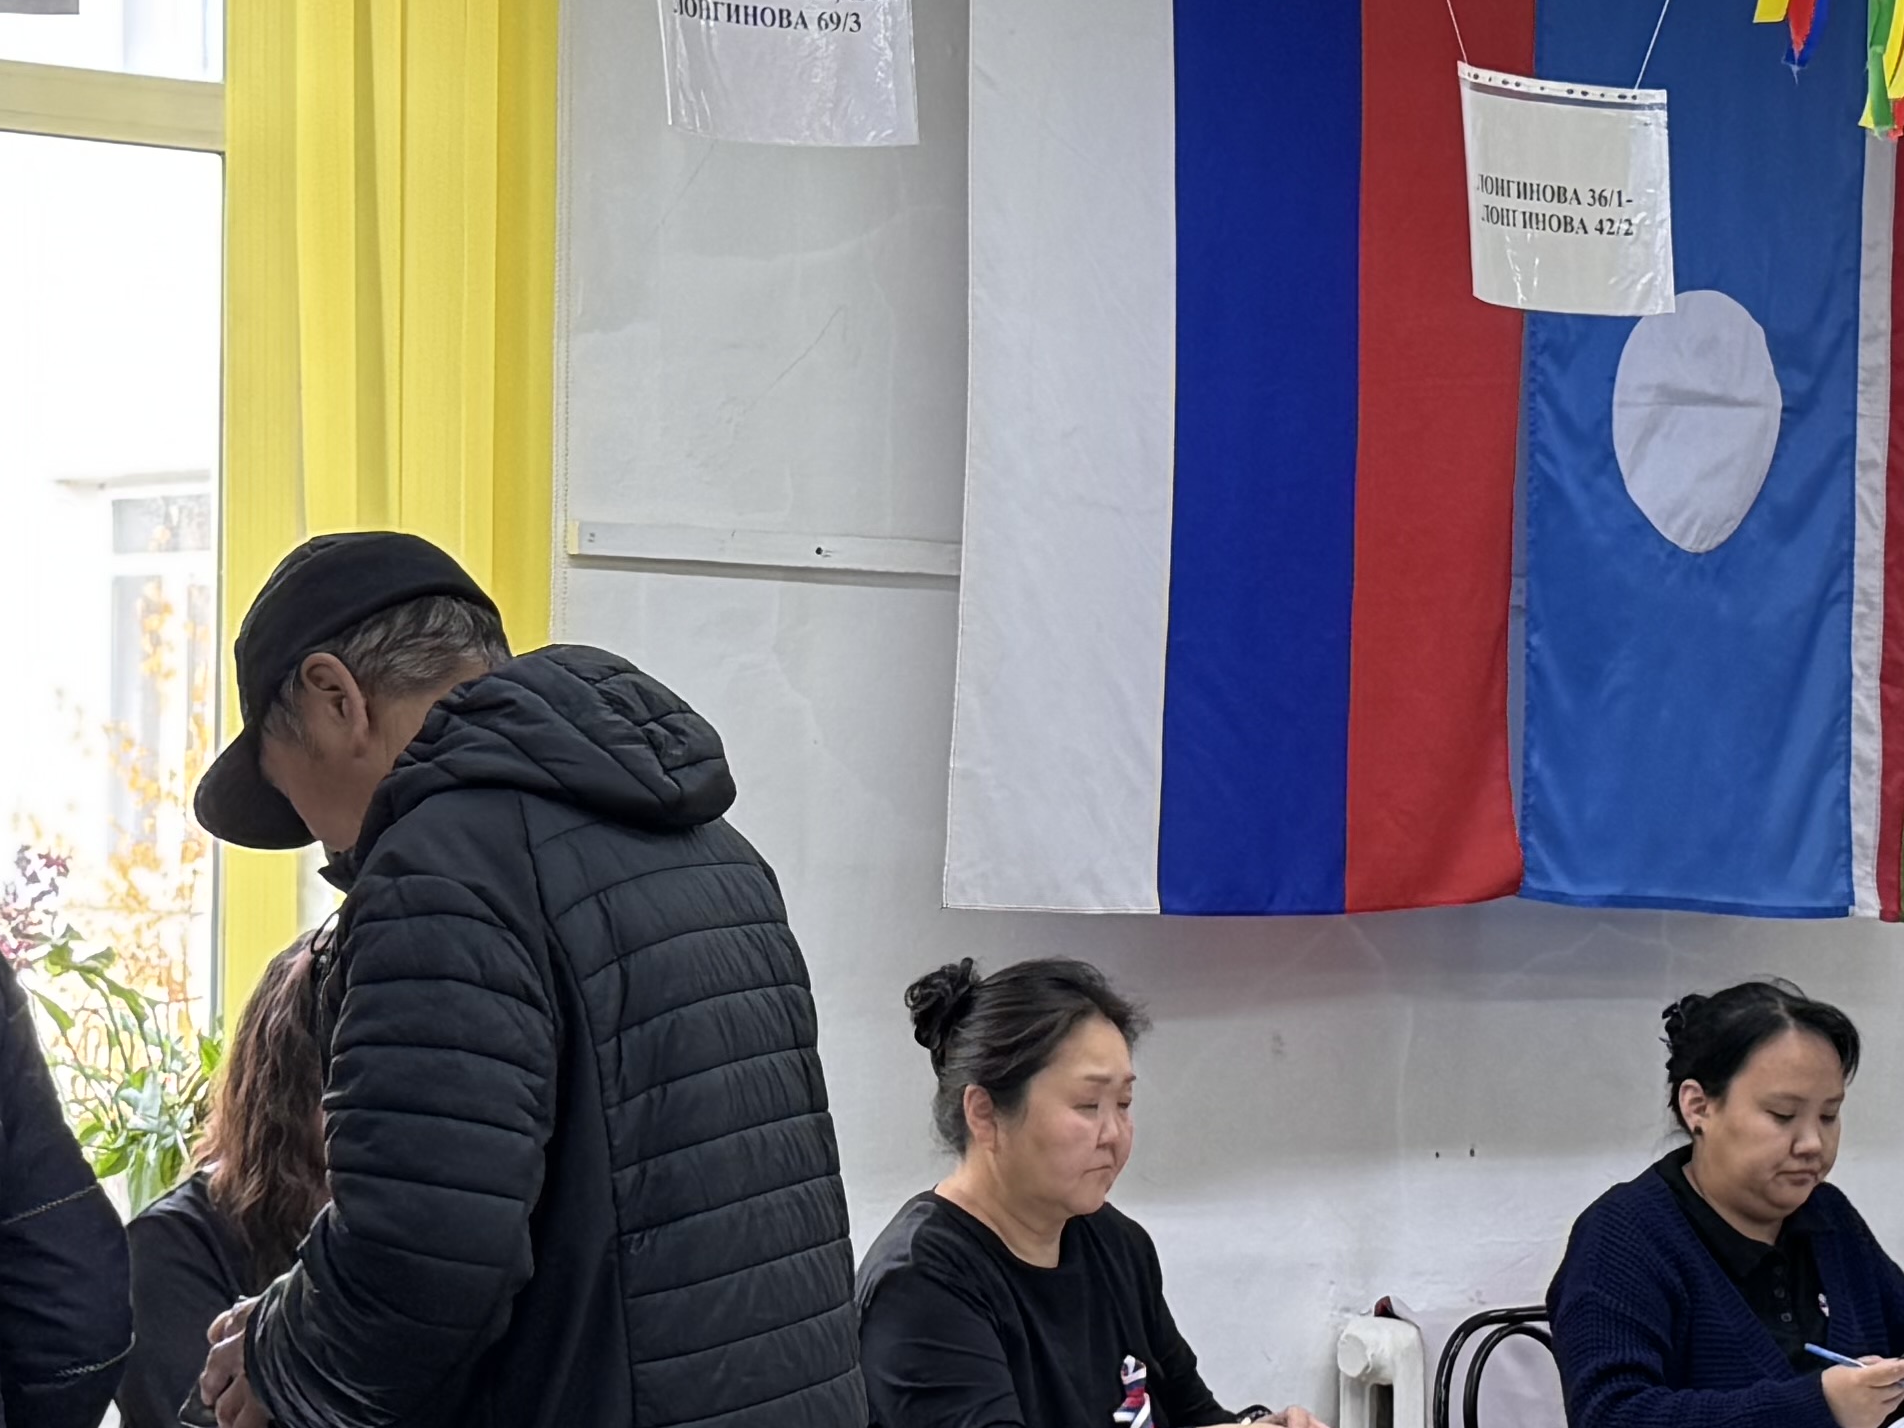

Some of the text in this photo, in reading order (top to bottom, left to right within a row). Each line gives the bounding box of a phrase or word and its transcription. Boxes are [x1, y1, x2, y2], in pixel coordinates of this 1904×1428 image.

[817, 11, 862, 33] 69/3
[1477, 173, 1634, 208] ЛОНГИНОВА 36/1-
[1481, 204, 1634, 236] ЛОНГИНОВА 42/2
